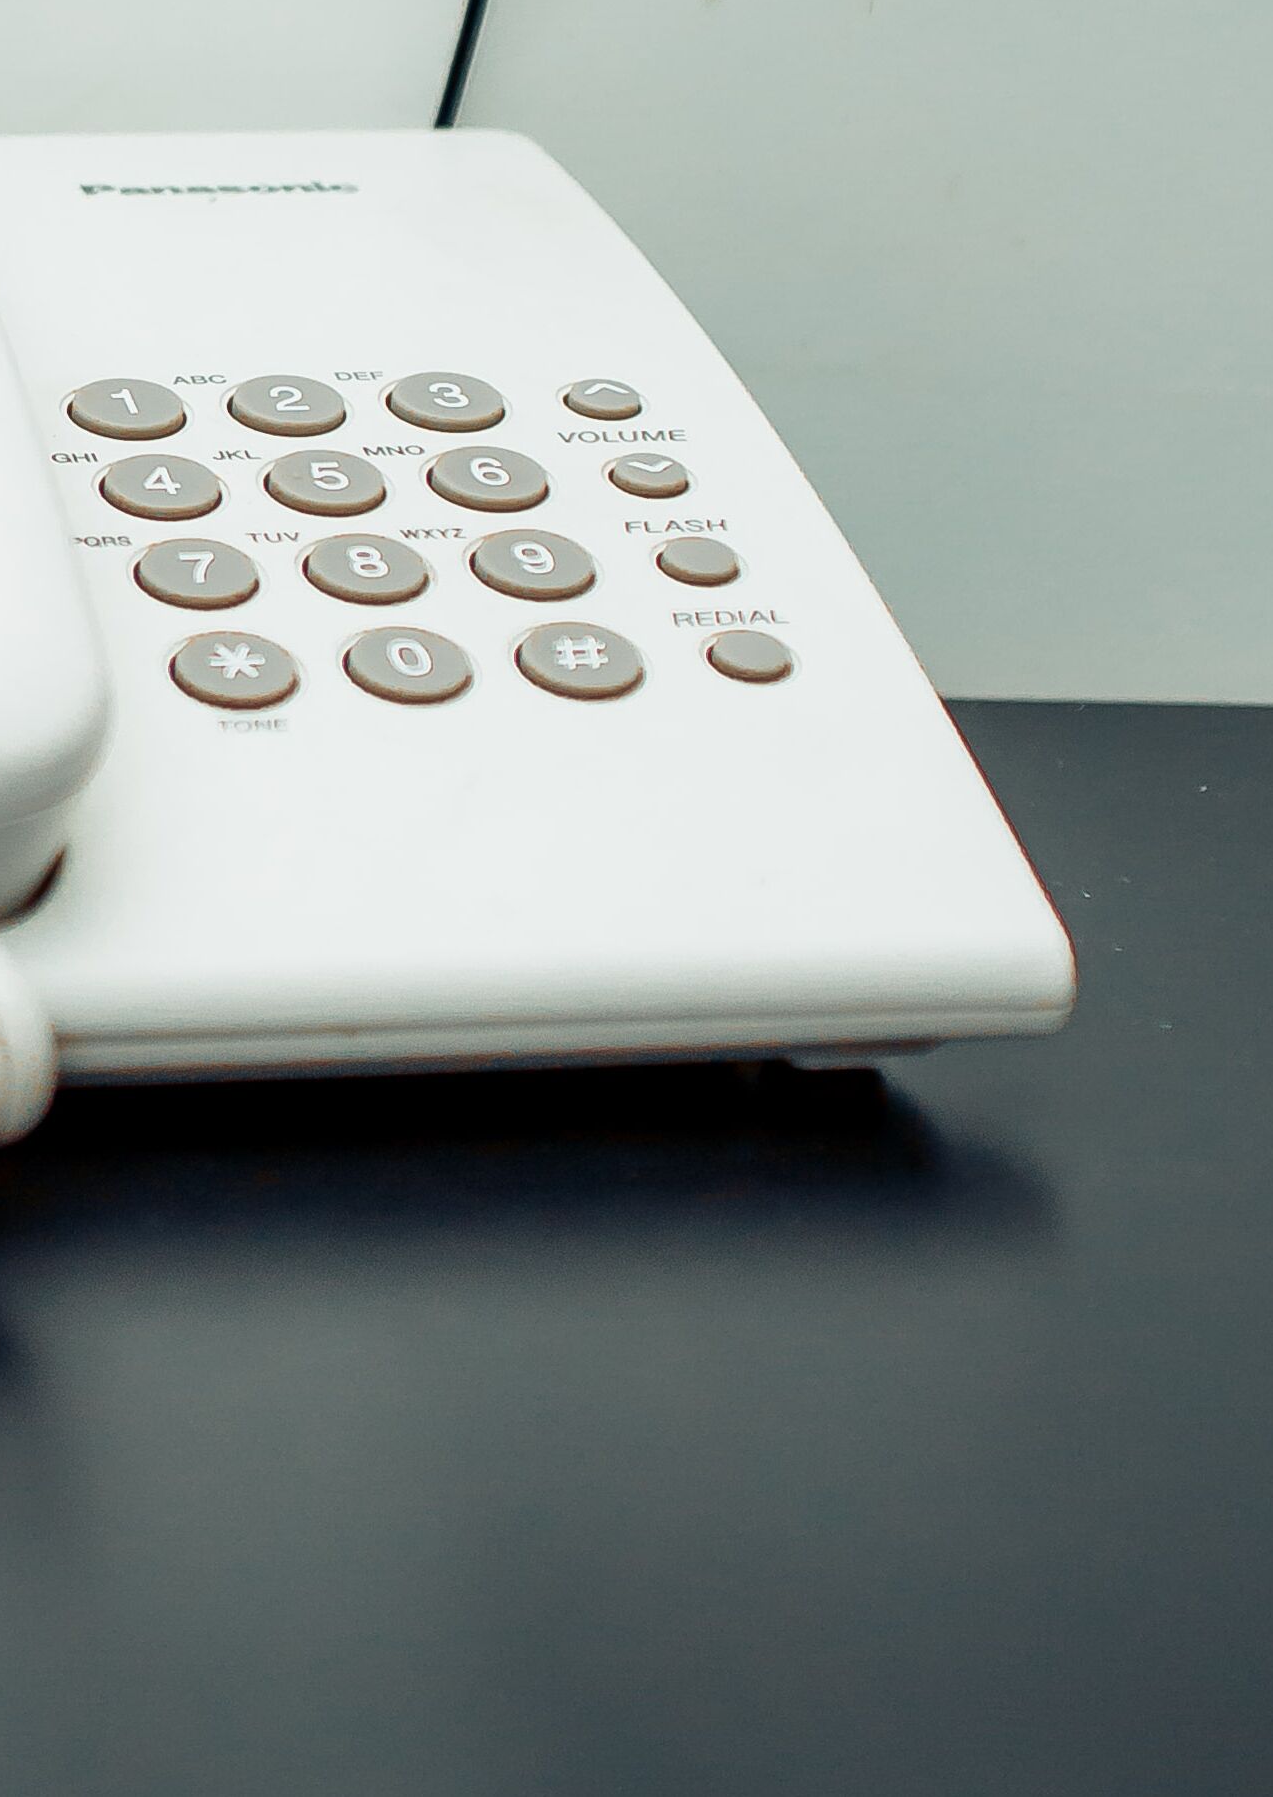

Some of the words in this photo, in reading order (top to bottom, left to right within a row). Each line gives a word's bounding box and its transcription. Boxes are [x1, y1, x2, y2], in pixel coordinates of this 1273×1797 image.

[172, 374, 227, 386] ABC
[333, 371, 384, 382] DEF
[111, 389, 138, 413] 1
[270, 387, 309, 410] 2
[430, 383, 468, 407] 3
[556, 429, 688, 444] VOLUME
[51, 452, 99, 464] GHI
[212, 449, 262, 461] JKL
[362, 445, 425, 457] MNO
[144, 467, 181, 494] 4
[311, 462, 348, 489] 5
[471, 458, 509, 485] 6
[399, 527, 466, 539] WXYZ
[624, 518, 728, 534] FLASH
[245, 531, 300, 544] TUV
[179, 552, 213, 583] 7
[347, 546, 388, 577] 8
[511, 543, 554, 573] 9
[672, 609, 789, 628] REDIAL
[387, 637, 433, 676] 0
